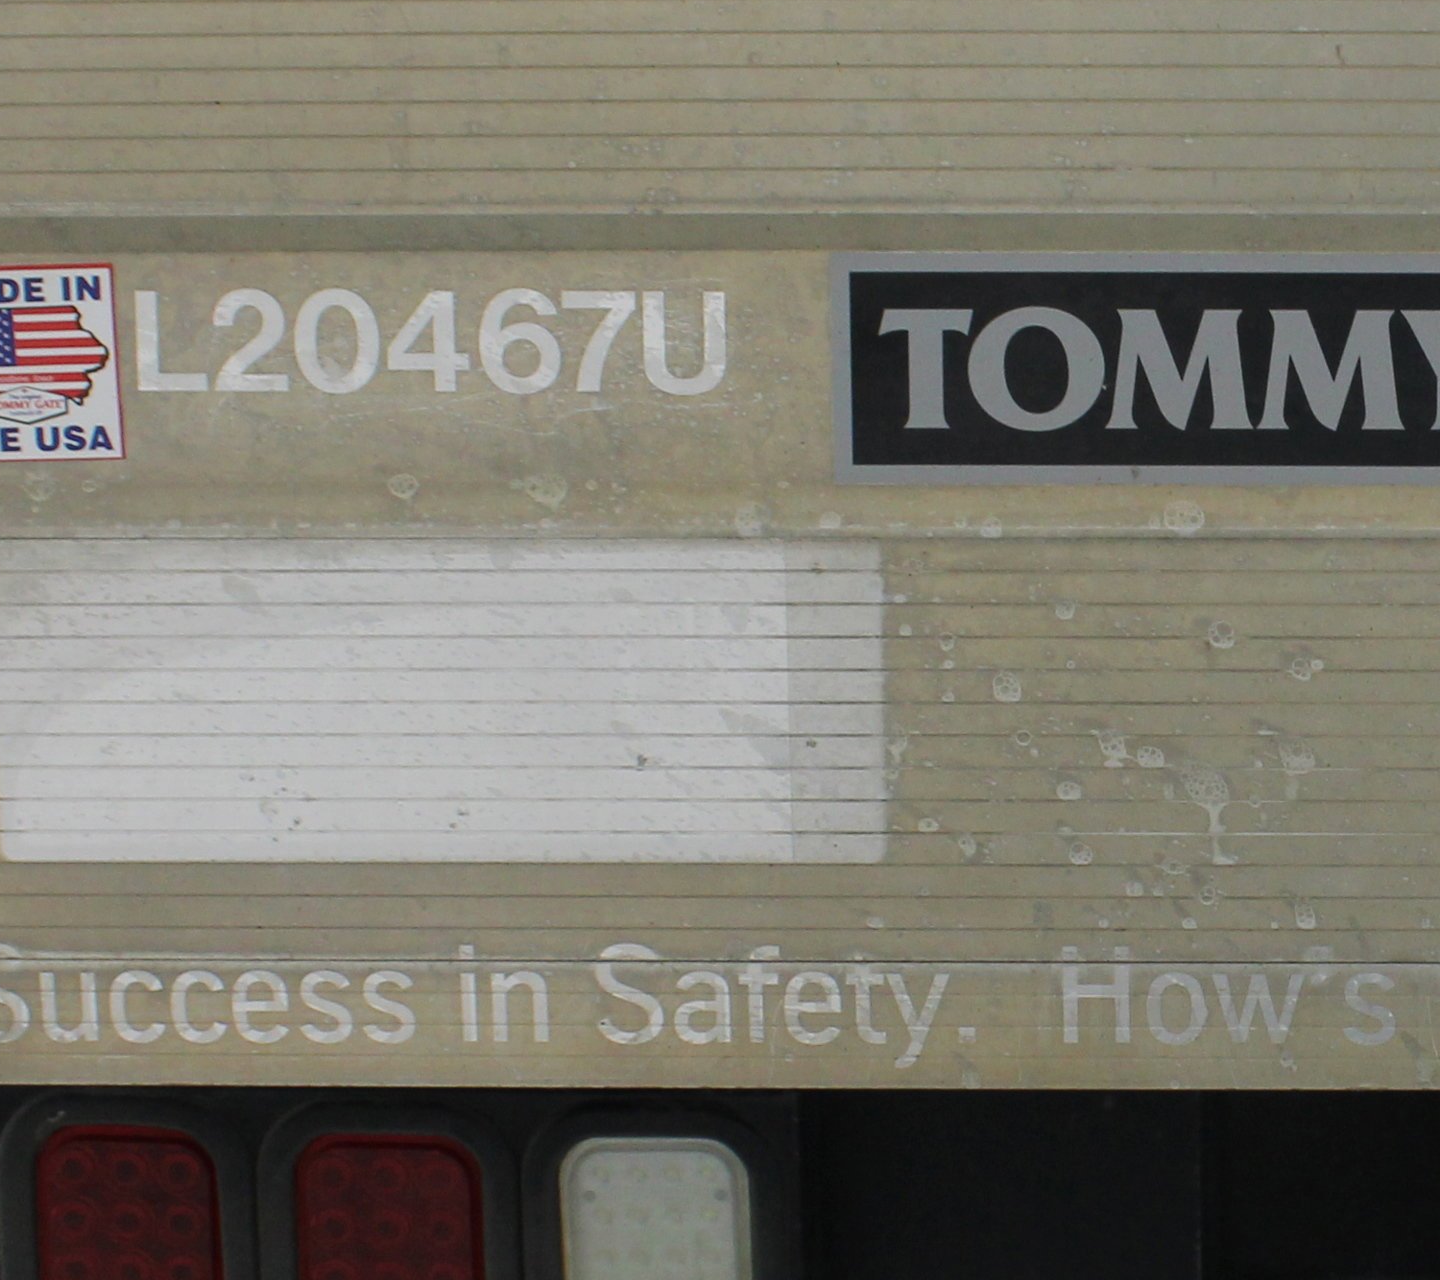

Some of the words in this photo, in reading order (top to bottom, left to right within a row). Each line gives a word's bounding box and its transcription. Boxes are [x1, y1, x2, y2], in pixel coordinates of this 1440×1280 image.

[61, 274, 102, 302] IN
[134, 288, 727, 395] L20467U
[35, 424, 115, 453] USA
[460, 944, 549, 1044] in
[1062, 946, 1397, 1047] How's
